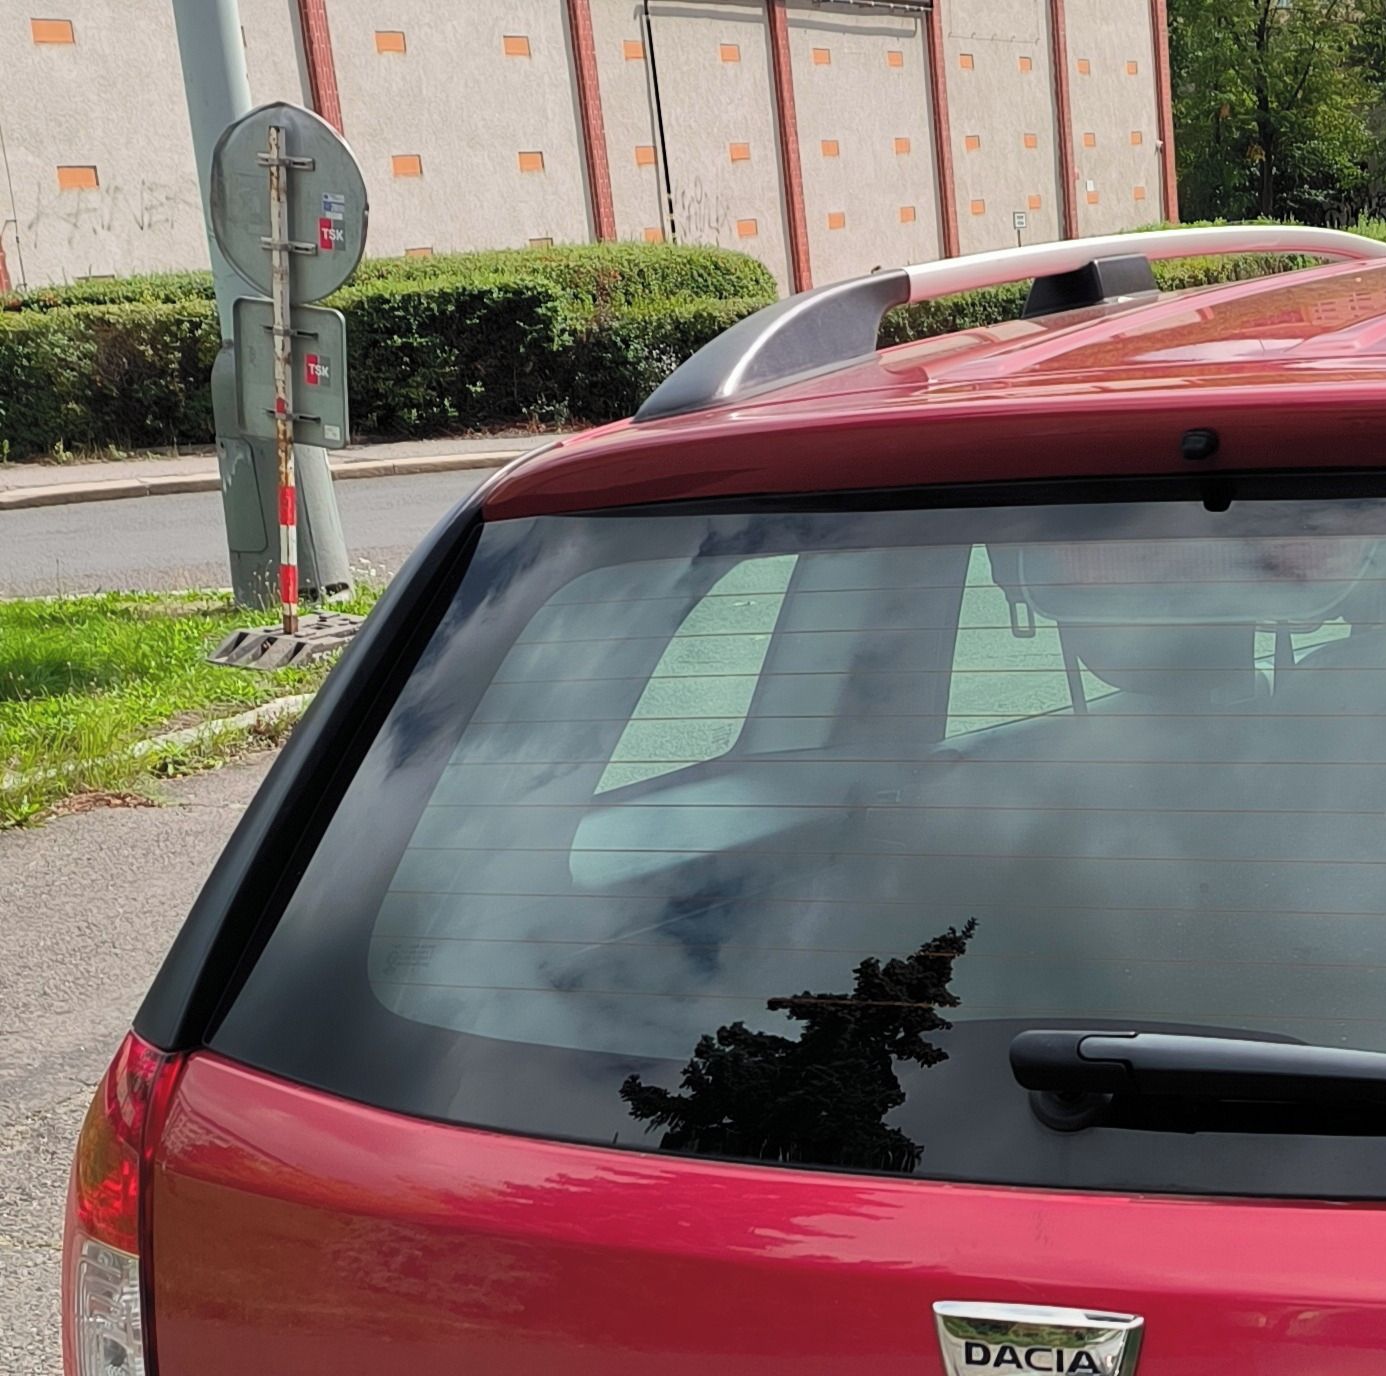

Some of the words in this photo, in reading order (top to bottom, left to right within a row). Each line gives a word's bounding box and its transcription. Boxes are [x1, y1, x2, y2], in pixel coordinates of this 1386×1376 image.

[321, 227, 345, 242] TSK
[308, 363, 330, 378] TSK
[964, 1341, 1101, 1374] DACIA
